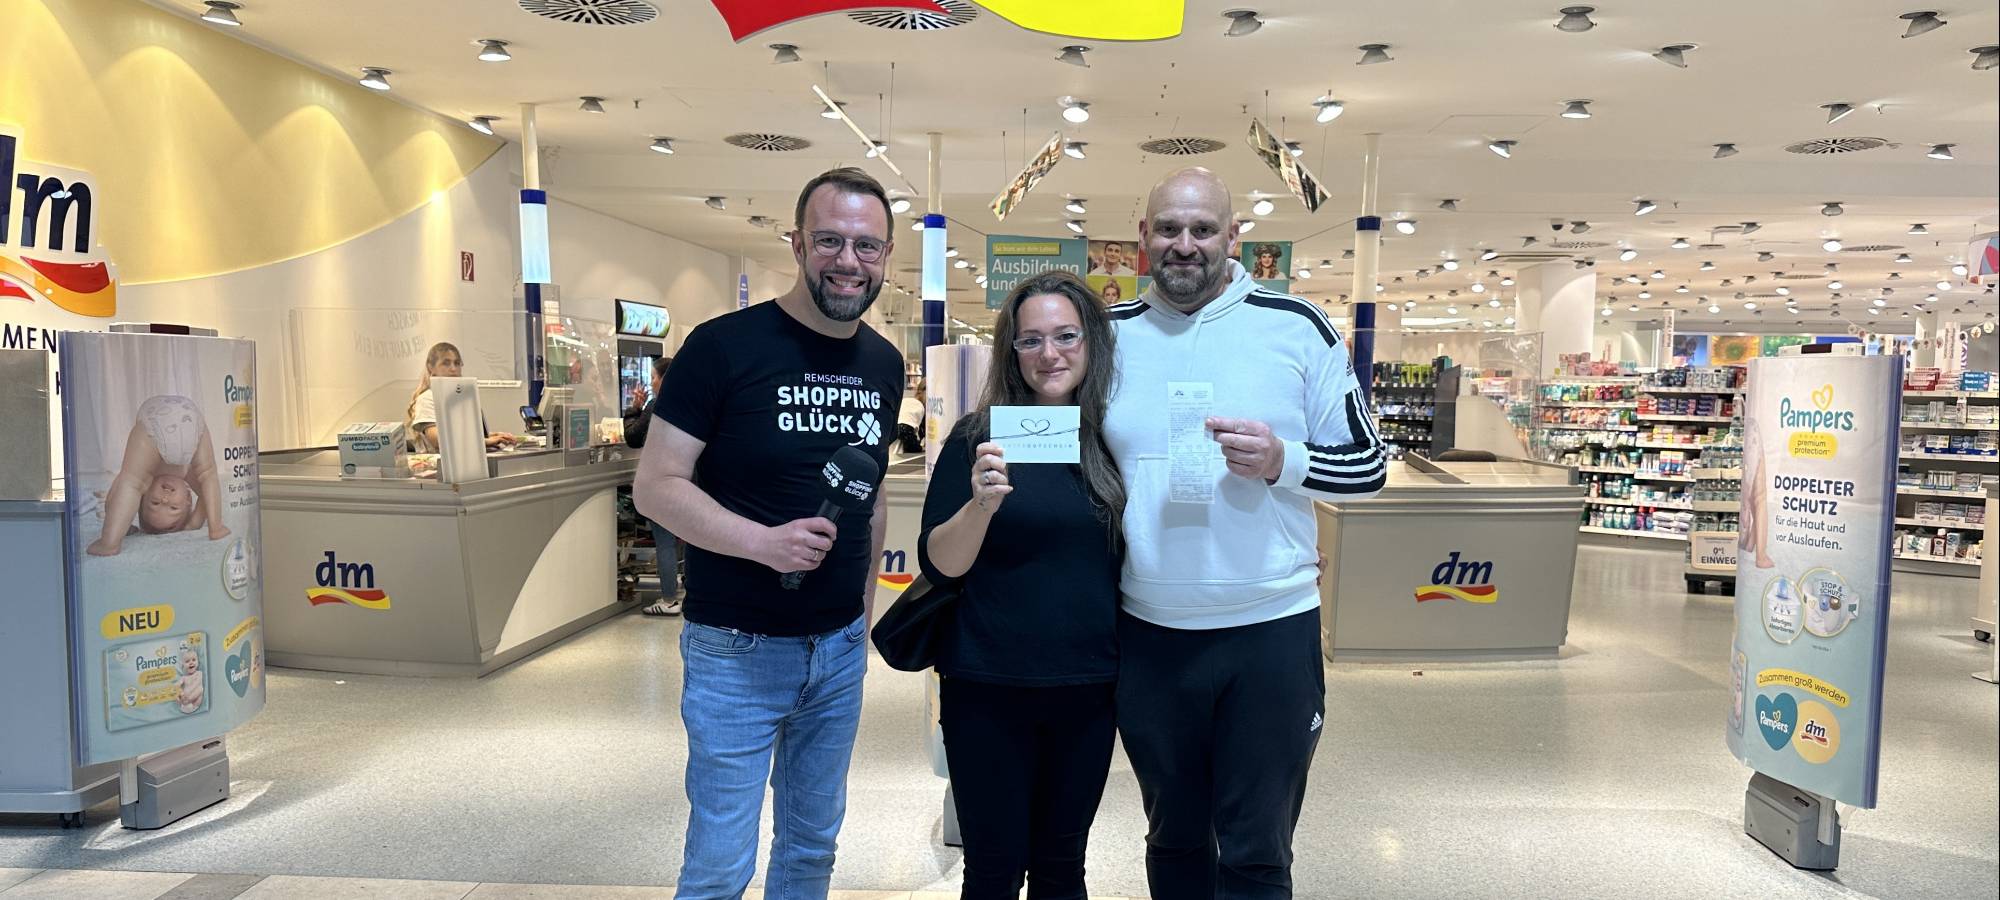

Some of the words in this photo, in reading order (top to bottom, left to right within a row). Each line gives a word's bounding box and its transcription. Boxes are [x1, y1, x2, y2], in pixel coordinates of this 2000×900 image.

[992, 258, 1079, 275] Ausbildung
[991, 278, 1017, 290] und
[805, 373, 863, 387] REMSCHEIDER
[777, 385, 881, 410] SHOPPING
[778, 408, 856, 434] GLÜCK
[1780, 397, 1855, 434] Pampers
[1797, 439, 1826, 449] premium
[1774, 475, 1855, 497] DOPPELTER
[1782, 496, 1838, 515] SCHUTZ
[1775, 514, 1785, 525] für
[1787, 516, 1798, 527] die
[1800, 518, 1825, 532] Haut
[1827, 523, 1846, 534] und
[1776, 534, 1787, 542] vor
[1788, 532, 1842, 550] Auslaufen.
[316, 551, 374, 588] dm
[882, 550, 906, 572] m
[1431, 551, 1493, 585] dm
[1701, 556, 1737, 565] EINWEG
[1819, 588, 1843, 597] SCHUTZ
[1820, 582, 1837, 590] STOP
[120, 610, 160, 632] NEU
[136, 655, 177, 671] Pampers
[1759, 674, 1793, 684] Zusammen
[1794, 676, 1813, 689] groß
[1814, 684, 1846, 704] werden
[1760, 710, 1789, 733] Pampers
[1805, 720, 1826, 737] dm
